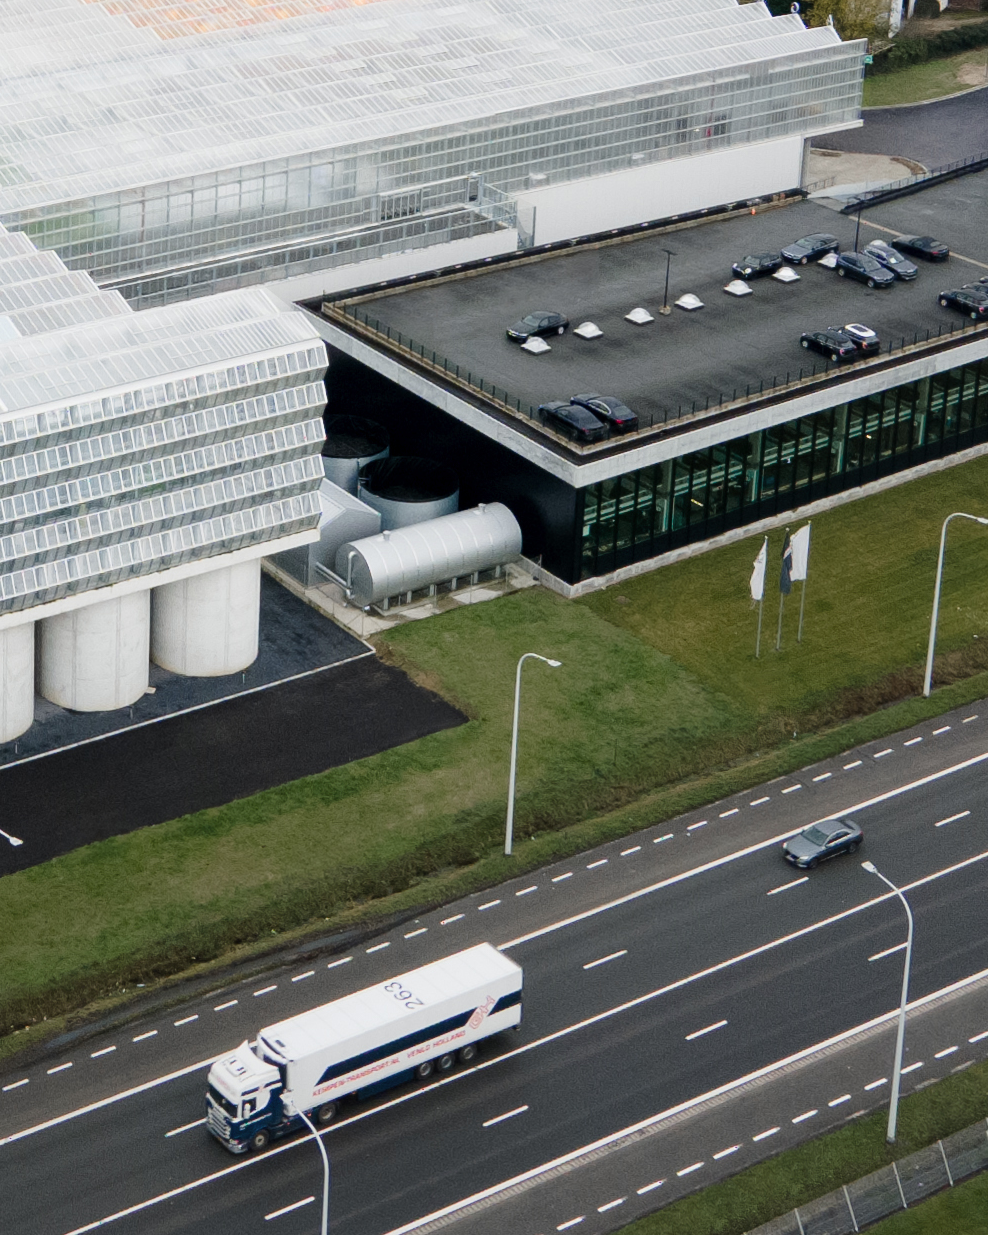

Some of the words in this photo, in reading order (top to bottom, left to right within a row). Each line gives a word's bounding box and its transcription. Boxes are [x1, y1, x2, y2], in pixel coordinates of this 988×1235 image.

[384, 981, 424, 1010] 263
[407, 1044, 431, 1058] VENLO
[432, 1030, 466, 1048] HOLLAND
